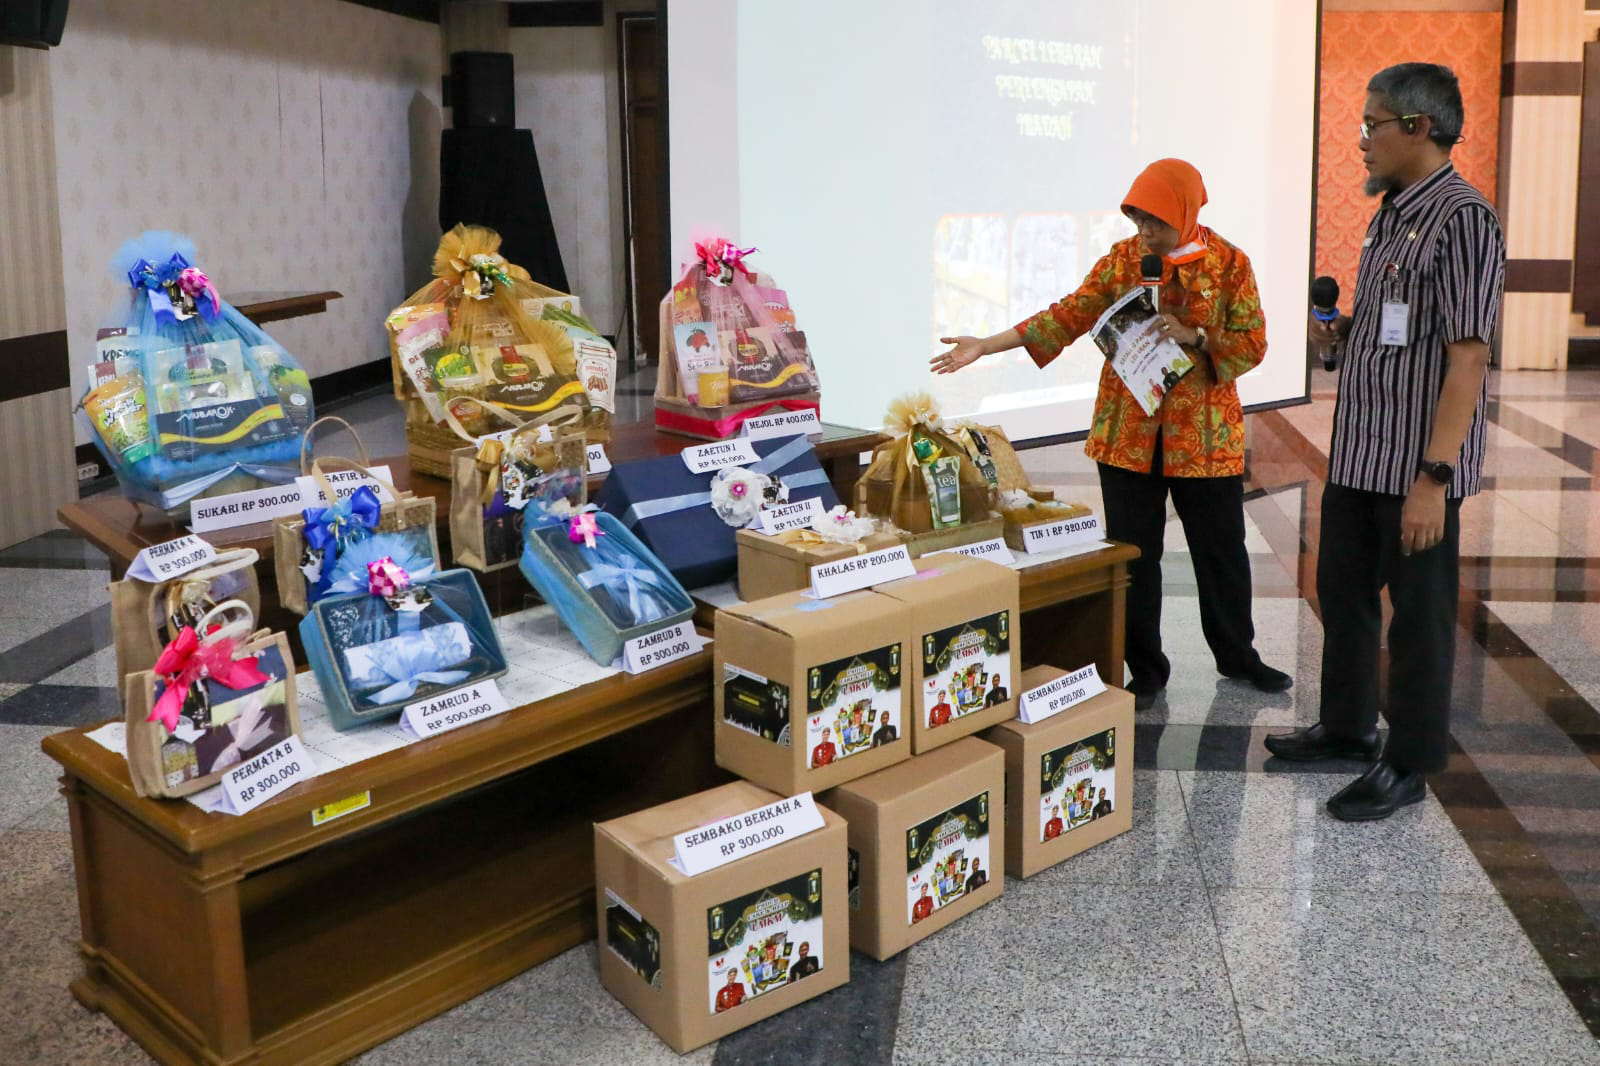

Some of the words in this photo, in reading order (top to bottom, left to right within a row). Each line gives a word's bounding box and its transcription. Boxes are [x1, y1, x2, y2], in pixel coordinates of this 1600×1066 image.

[749, 419, 774, 429] MEJOL
[774, 417, 784, 426] RP
[786, 413, 815, 424] 400.000
[697, 444, 730, 457] ZAETUN
[937, 474, 957, 488] tea
[198, 503, 239, 519] SUKARI
[242, 501, 255, 511] RP
[258, 492, 300, 508] 300.000
[771, 503, 803, 518] ZAETUN
[804, 501, 811, 510] II
[774, 522, 785, 531] RP
[1029, 529, 1044, 540] TIN
[1052, 526, 1063, 536] RP
[1064, 519, 1097, 535] 920.000
[149, 540, 187, 559] PERMATA
[188, 537, 197, 545] A
[971, 542, 1000, 555] 615.000
[159, 563, 172, 573] RP
[172, 549, 207, 569] 300.000
[817, 561, 855, 578] KHALAS
[857, 558, 868, 570] RP
[870, 550, 905, 566] 200.000
[637, 630, 674, 649] ZAMRUD
[675, 627, 682, 637] B
[640, 654, 652, 666] RP
[653, 641, 690, 661] 300.000
[1028, 682, 1061, 702] SEMBAKO
[1061, 670, 1088, 688] BERKAH
[1088, 668, 1094, 676] B
[420, 693, 470, 717] ZAMRUD
[472, 689, 481, 700] A
[1049, 699, 1059, 711] RP
[1060, 688, 1086, 706] 200.000
[427, 720, 442, 731] RP
[445, 703, 492, 725] 500.000
[232, 748, 284, 784] PERMATA
[284, 742, 293, 754] B
[240, 786, 255, 802] RP
[257, 762, 301, 792] 300.000
[685, 819, 742, 848] SEMBAKO
[744, 802, 792, 827] BERKAH
[793, 799, 802, 810] A
[720, 842, 736, 856] RP
[738, 825, 784, 849] 300.000
